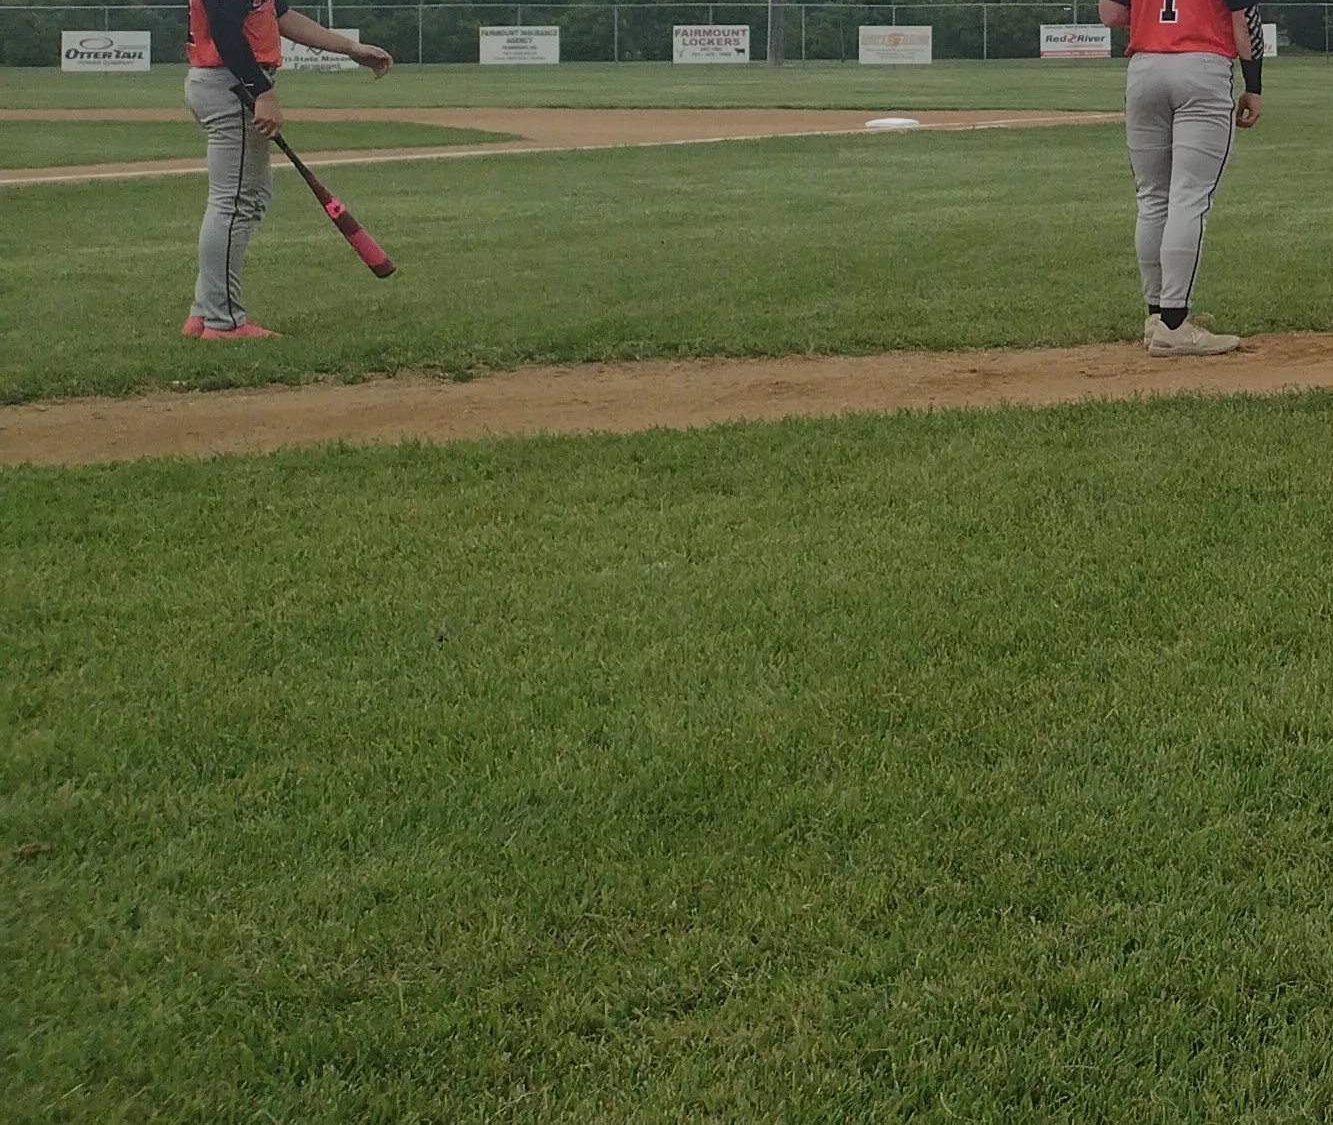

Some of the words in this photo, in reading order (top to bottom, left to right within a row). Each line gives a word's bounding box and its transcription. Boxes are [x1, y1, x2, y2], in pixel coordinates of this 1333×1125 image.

[674, 29, 748, 37] FAIRMOUNT
[682, 37, 740, 46] LOCKERS
[1045, 34, 1067, 43] Red
[1077, 34, 1106, 43] River
